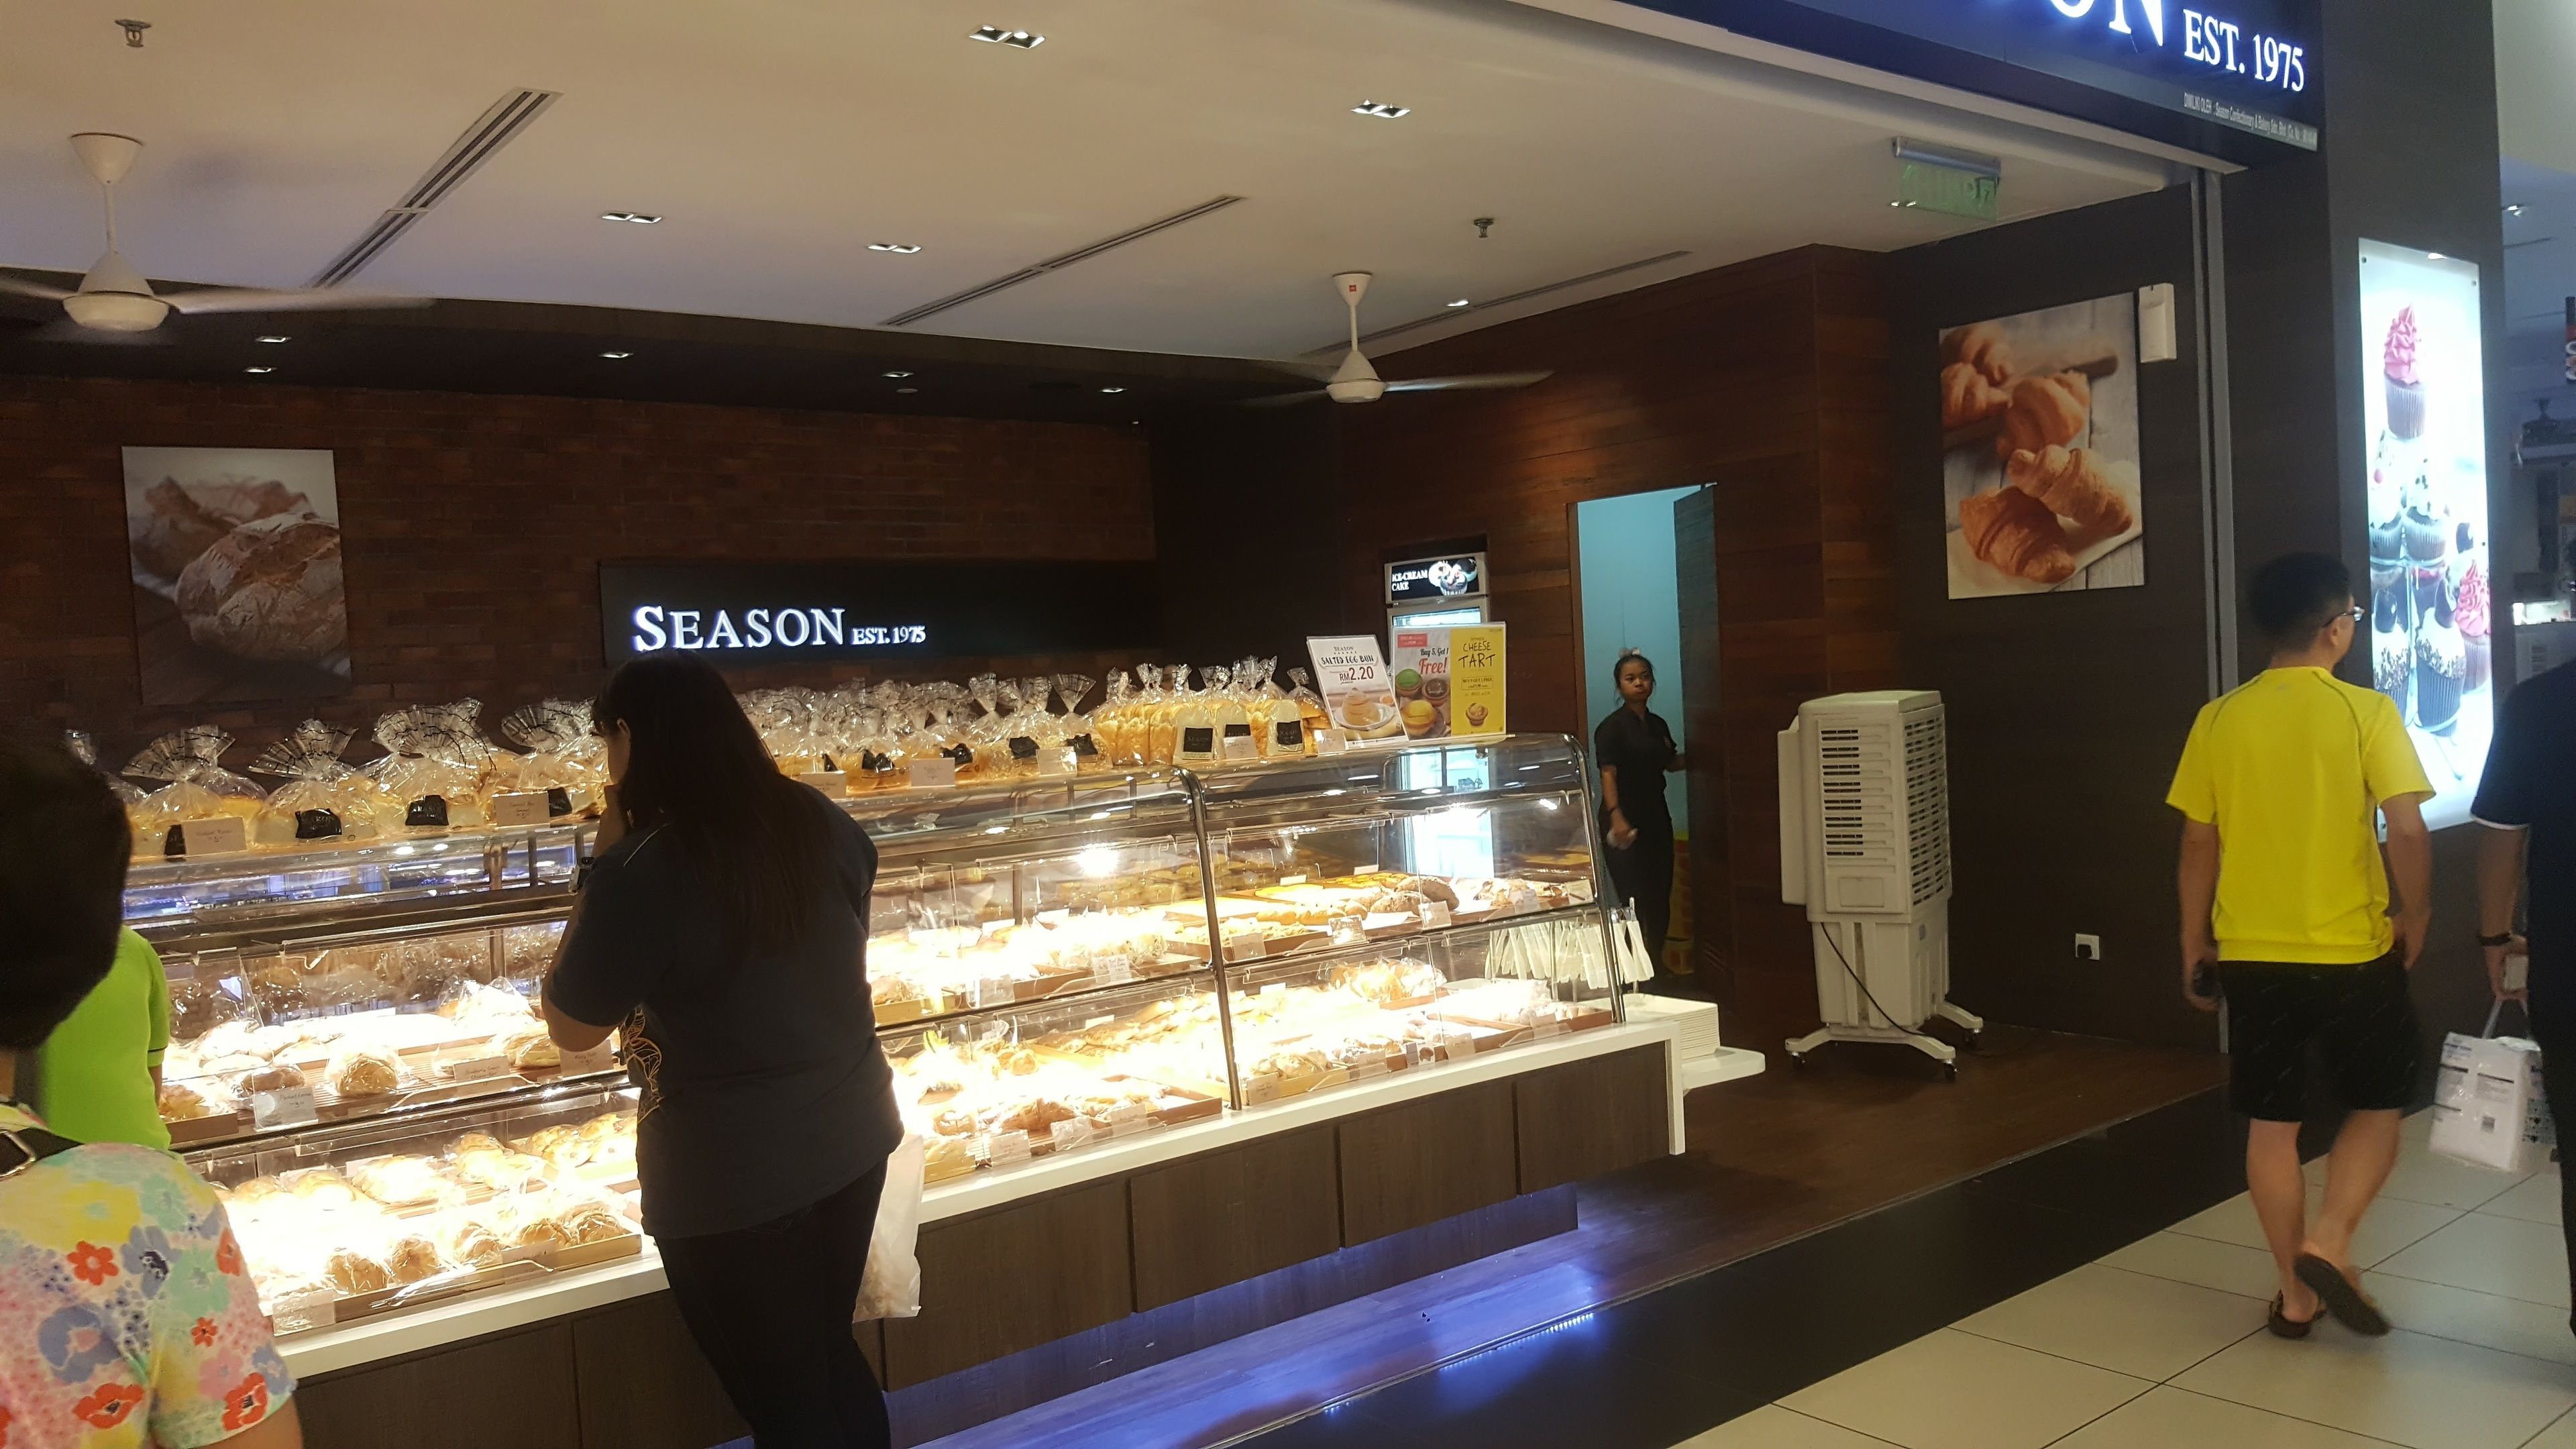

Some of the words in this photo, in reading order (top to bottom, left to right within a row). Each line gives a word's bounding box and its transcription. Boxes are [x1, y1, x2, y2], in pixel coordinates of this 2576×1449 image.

[2183, 9, 2245, 74] EST.
[2253, 34, 2304, 92] 1975
[1392, 570, 1428, 582] ICE-CREAM
[1391, 581, 1409, 592] CAKE
[634, 604, 846, 651] SEASON
[851, 627, 891, 645] EST.
[892, 625, 926, 644] 1975
[1420, 648, 1431, 657] Buy
[1437, 647, 1446, 657] Get
[1463, 640, 1492, 652] CHEESE
[1321, 656, 1344, 665] SALTED
[1359, 655, 1375, 663] BUN
[1419, 657, 1448, 675] Free!
[1458, 653, 1496, 668] TART
[1339, 665, 1375, 682] RM2.20
